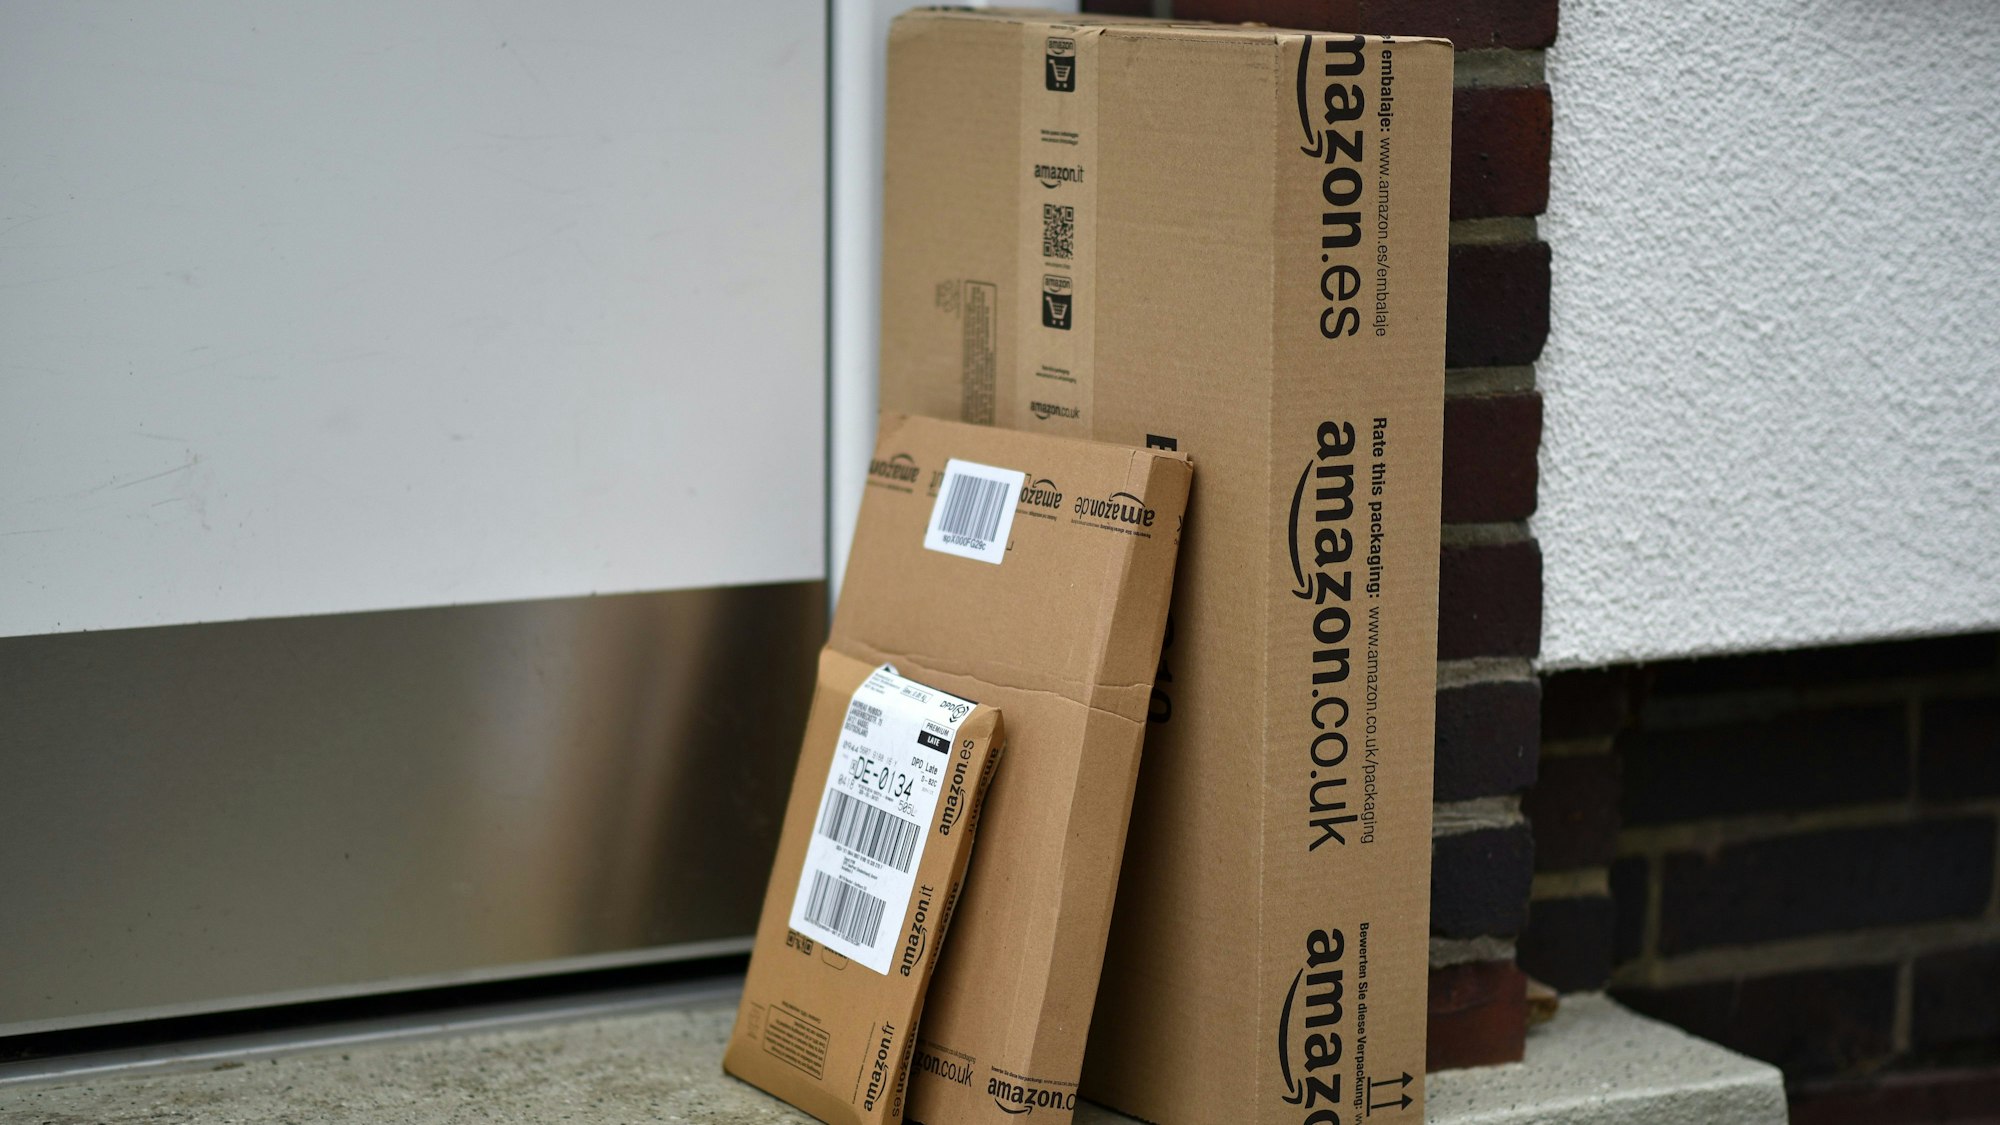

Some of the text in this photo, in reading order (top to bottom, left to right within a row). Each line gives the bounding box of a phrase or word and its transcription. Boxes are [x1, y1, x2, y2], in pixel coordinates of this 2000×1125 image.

[1048, 38, 1074, 51] amazon
[1377, 49, 1395, 132] embalaje:
[1034, 163, 1085, 184] amazon.it
[1319, 34, 1366, 340] mazon.es
[1372, 137, 1390, 337] www.amazon.es/embalaje
[1045, 276, 1071, 290] amazon
[1030, 401, 1081, 420] amazon.co.uk
[870, 459, 920, 483] amazon
[1020, 487, 1063, 509] amazo
[1074, 496, 1156, 527] amazon.de
[1308, 421, 1359, 852] amazon.co.uk
[1360, 417, 1388, 844] Rate this packaging: www.amazon.co.uk/packaging
[940, 700, 956, 711] DPD
[926, 722, 949, 736] PREMIUM
[927, 735, 941, 747] LATE
[854, 755, 914, 801] DE-0134
[939, 739, 975, 836] amazon.es
[900, 884, 934, 977] amazon.it
[1358, 922, 1369, 979] Bewerten
[1358, 981, 1368, 1000] Sie
[1357, 1003, 1368, 1035] diese
[863, 1021, 895, 1112] amazon.fr
[916, 1050, 973, 1087] zon.co.uk
[1353, 1036, 1366, 1110] Verpackung:
